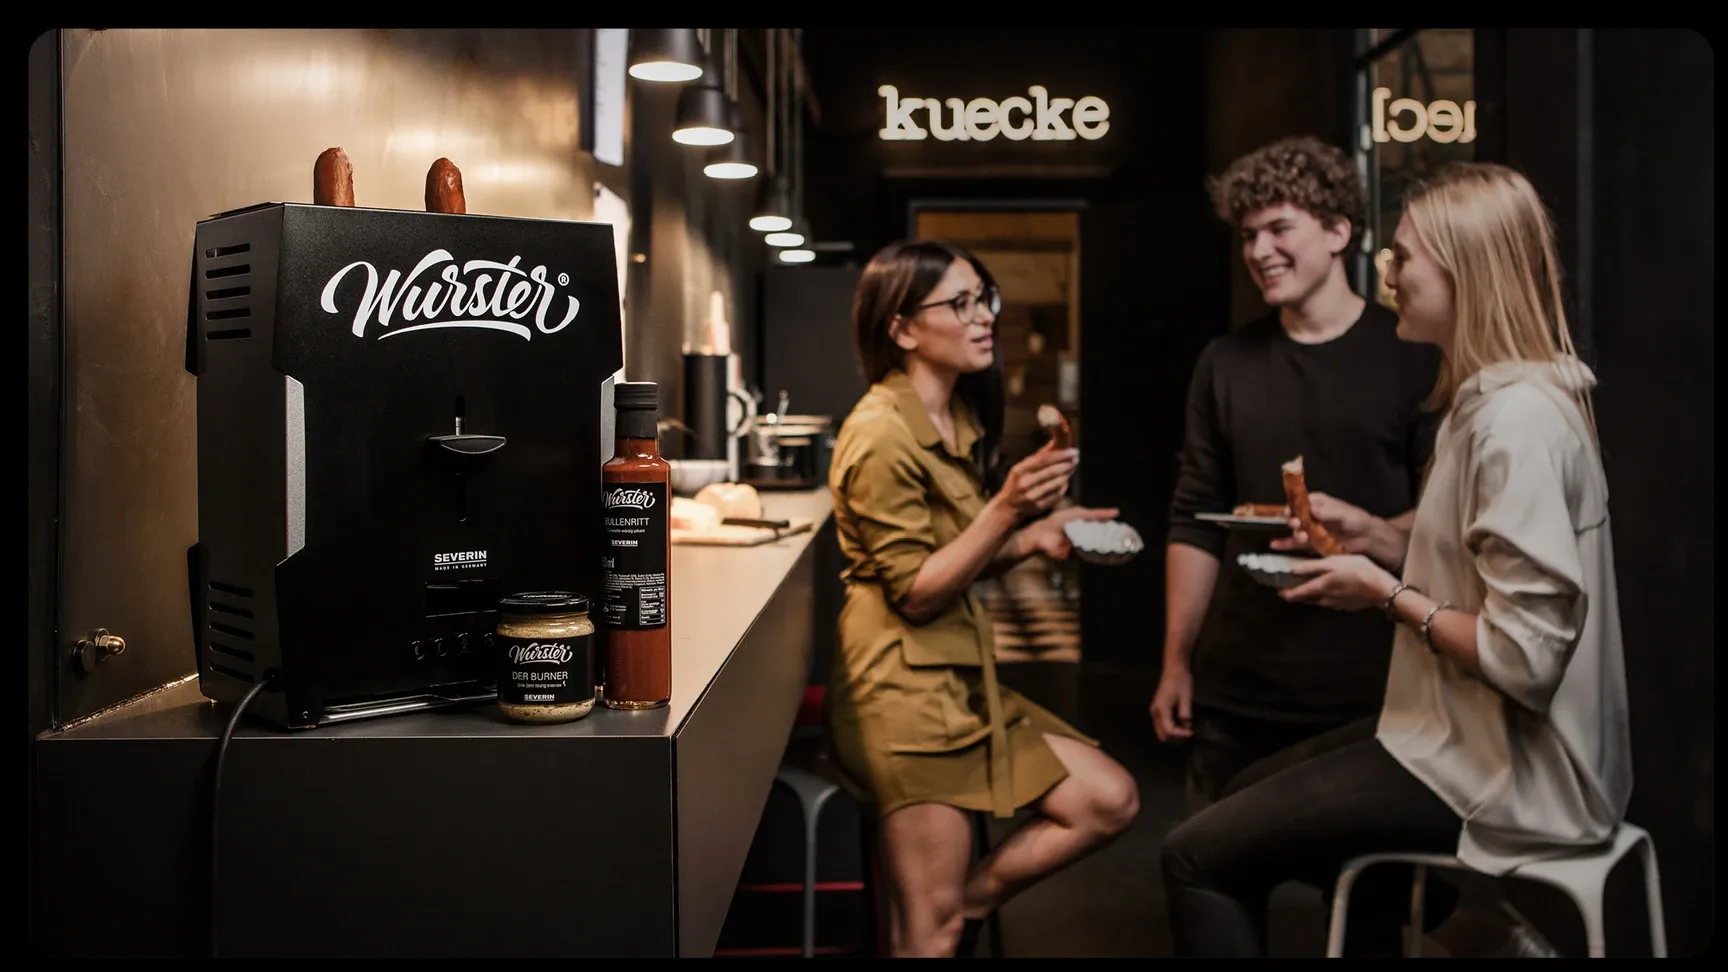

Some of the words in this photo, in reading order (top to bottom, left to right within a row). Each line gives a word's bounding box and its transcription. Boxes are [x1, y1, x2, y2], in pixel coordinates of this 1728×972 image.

[878, 84, 1110, 141] kuecke
[434, 550, 487, 563] SEVERIN
[508, 642, 573, 665] Wurster
[512, 671, 529, 681] DER
[530, 671, 569, 681] BURNER
